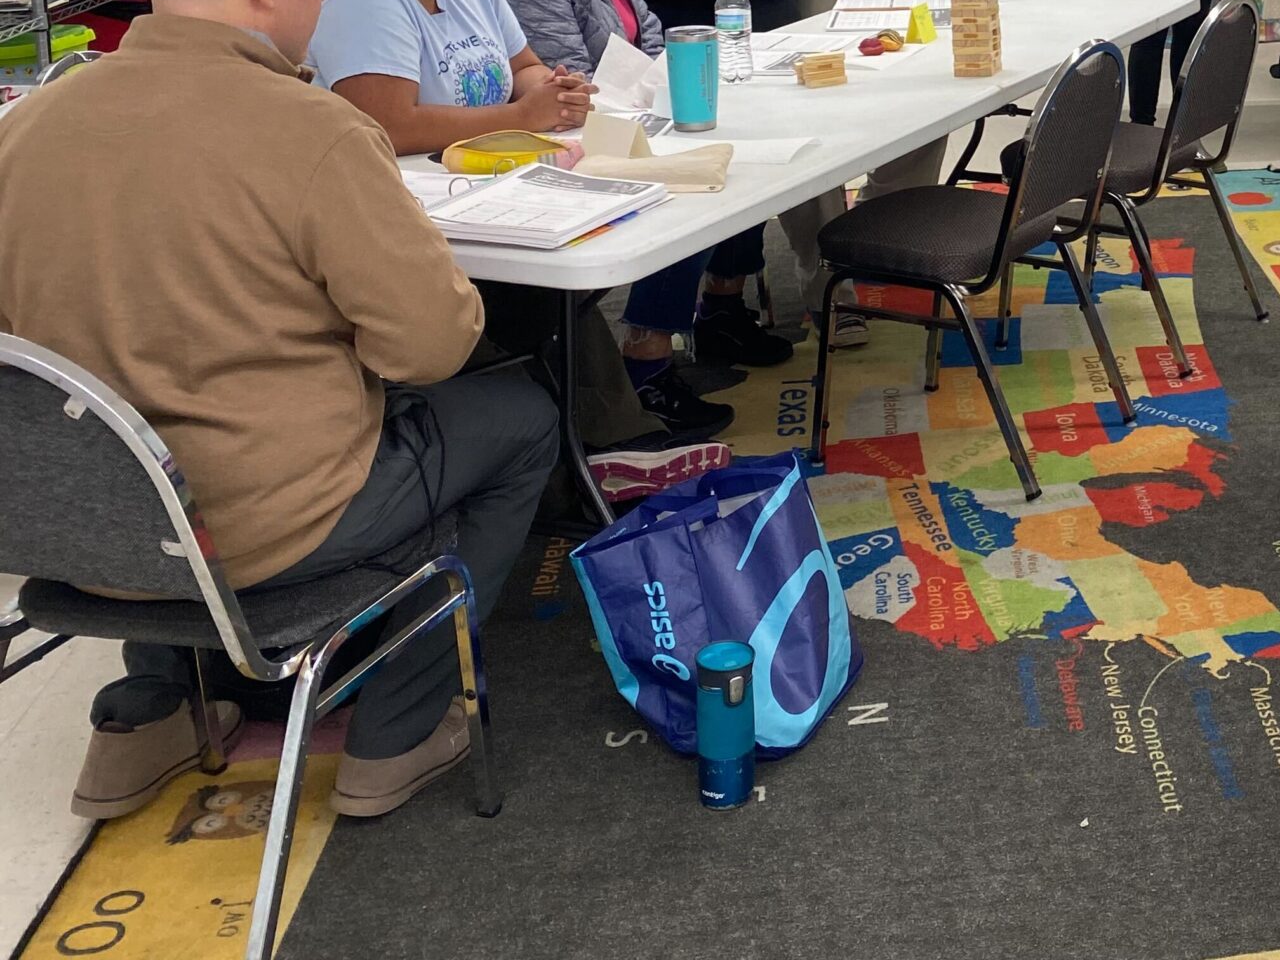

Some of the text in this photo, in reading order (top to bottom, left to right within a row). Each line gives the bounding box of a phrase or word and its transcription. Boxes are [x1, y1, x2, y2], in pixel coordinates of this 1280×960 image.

[776, 375, 819, 438] Texas
[882, 387, 900, 436] Oklahoma
[1055, 412, 1078, 442] Iowa
[1130, 400, 1219, 433] Minnesota
[854, 440, 912, 478] Arkansas
[898, 482, 953, 552] Tennessee
[947, 491, 1000, 552] Kentucky
[1134, 486, 1155, 522] Michigan
[531, 536, 574, 596] Hawaii
[897, 573, 913, 604] South
[874, 572, 889, 615] Carolina
[926, 576, 946, 631] Carolina
[952, 582, 976, 620] North
[1205, 589, 1230, 623] New
[1055, 659, 1085, 733] Delaware
[1101, 663, 1138, 754] New Jersey
[1137, 706, 1184, 814] Connecticut
[55, 890, 145, 956] Oo
